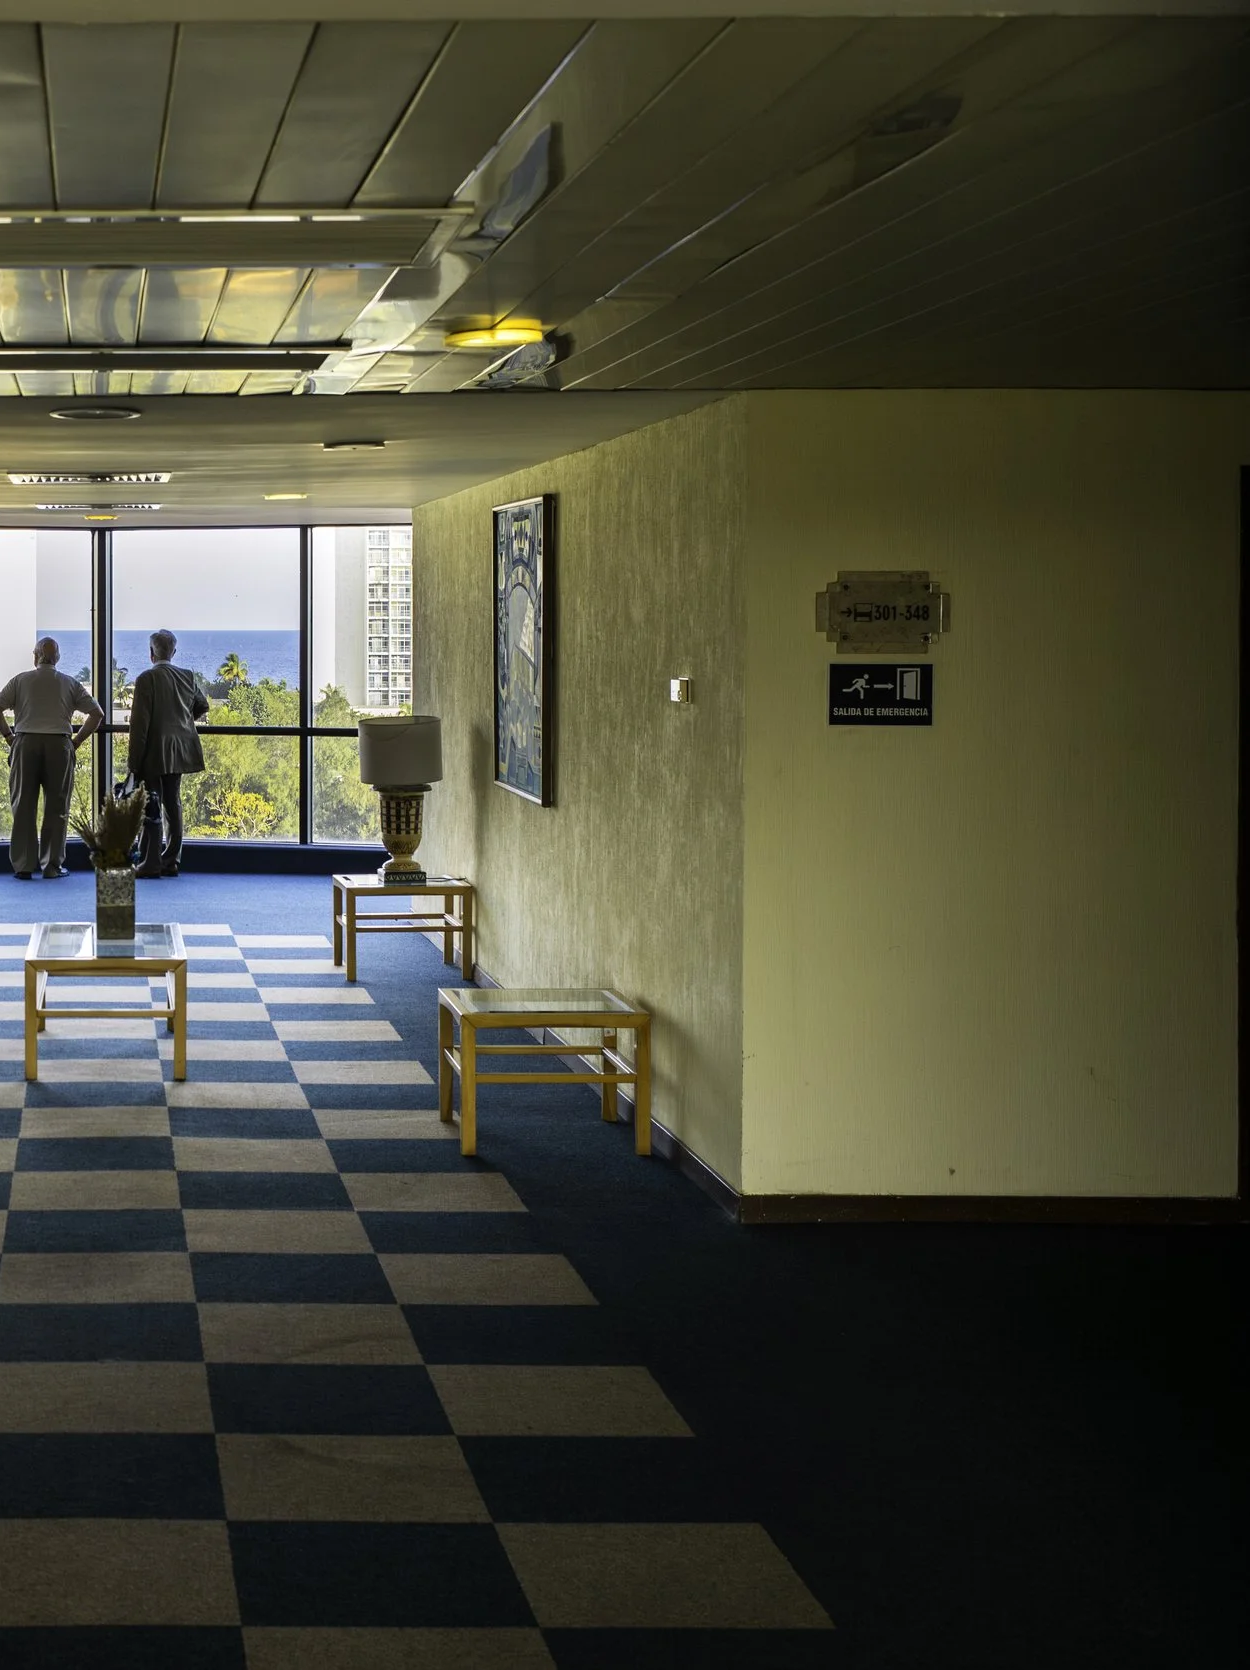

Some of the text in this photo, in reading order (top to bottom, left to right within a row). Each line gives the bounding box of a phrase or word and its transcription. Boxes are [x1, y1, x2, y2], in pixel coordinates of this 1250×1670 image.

[873, 604, 930, 621] 301-348
[833, 707, 929, 717] SALIDA DE EMERGENCIA
